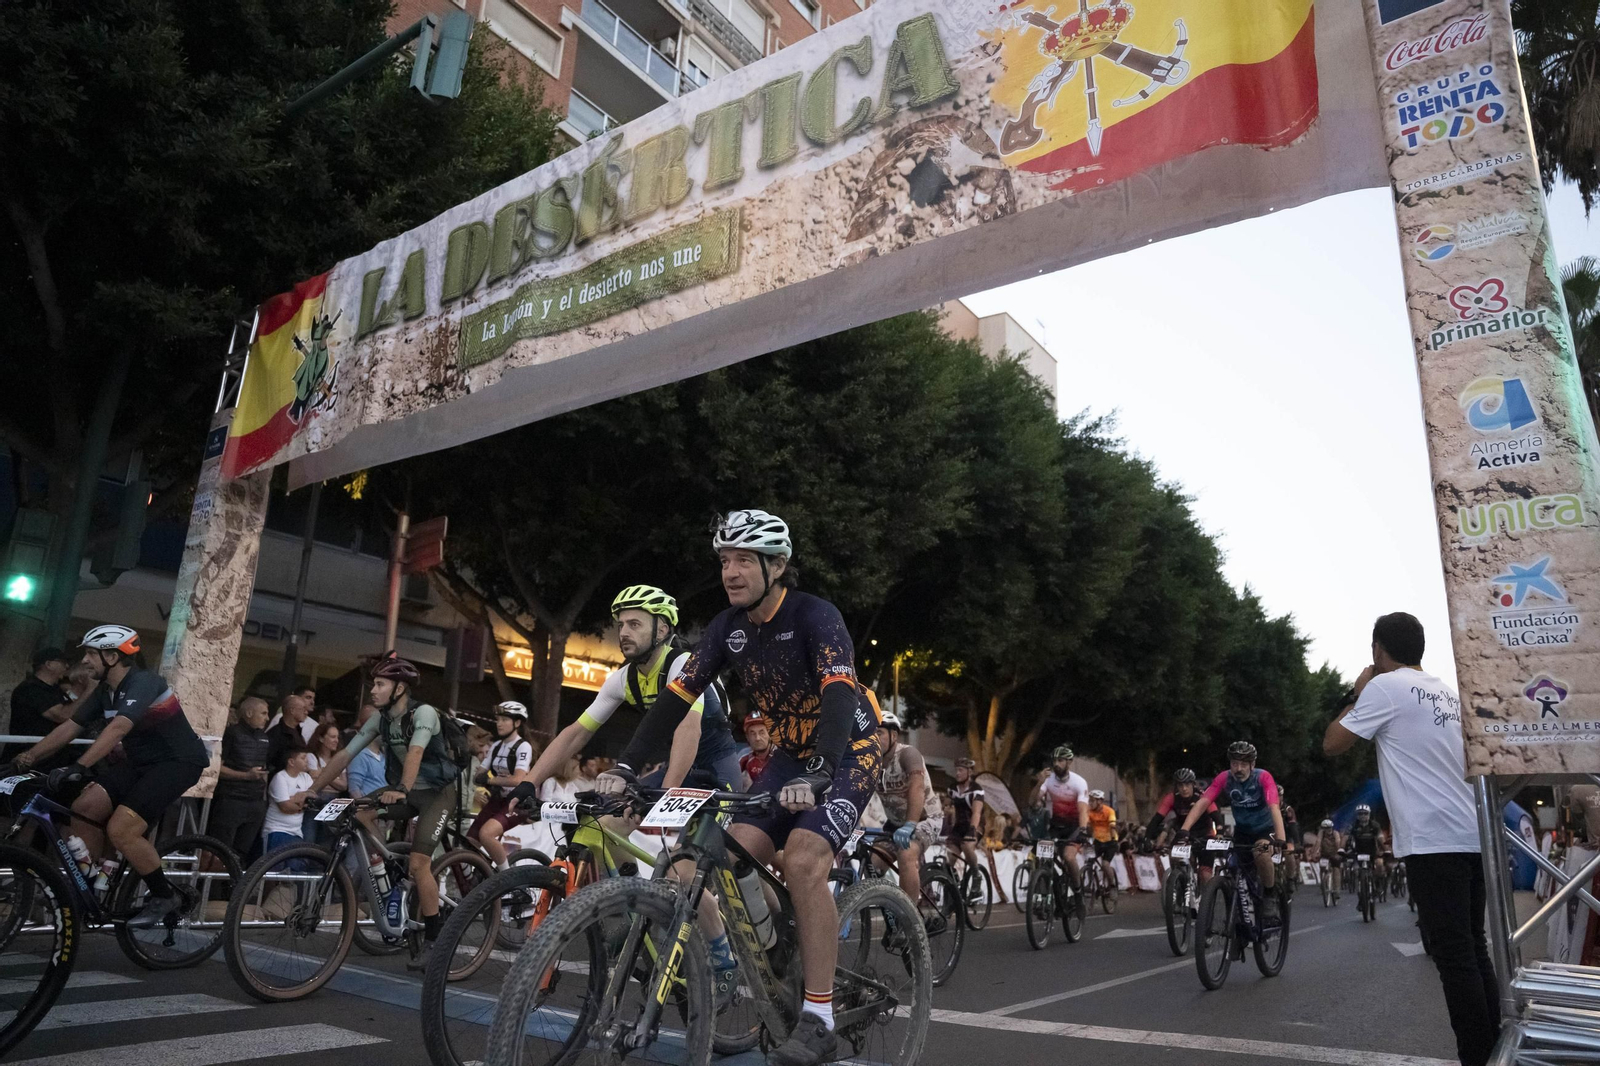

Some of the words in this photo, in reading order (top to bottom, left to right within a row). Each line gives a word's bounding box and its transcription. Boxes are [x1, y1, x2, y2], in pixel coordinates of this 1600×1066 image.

[1386, 12, 1490, 70] Coca-Cola
[1397, 65, 1493, 103] GRUPO
[1399, 79, 1501, 125] RENTA
[1401, 102, 1504, 148] TODO
[357, 248, 425, 340] LA
[440, 11, 961, 306] DESÉRTICA
[1460, 211, 1527, 236] Andalucía
[1483, 228, 1511, 239] Europea
[481, 321, 496, 342] La
[541, 299, 553, 320] y
[559, 288, 571, 311] el
[579, 269, 632, 303] desierto
[639, 257, 665, 280] nos
[673, 243, 702, 268] une
[1431, 310, 1547, 350] primaflor
[1470, 435, 1543, 456] Almería
[1477, 451, 1541, 469] Activa
[1492, 612, 1579, 630] Fundación
[1411, 686, 1443, 708] Pepe
[659, 798, 703, 813] 5045
[57, 838, 88, 891] cannondale
